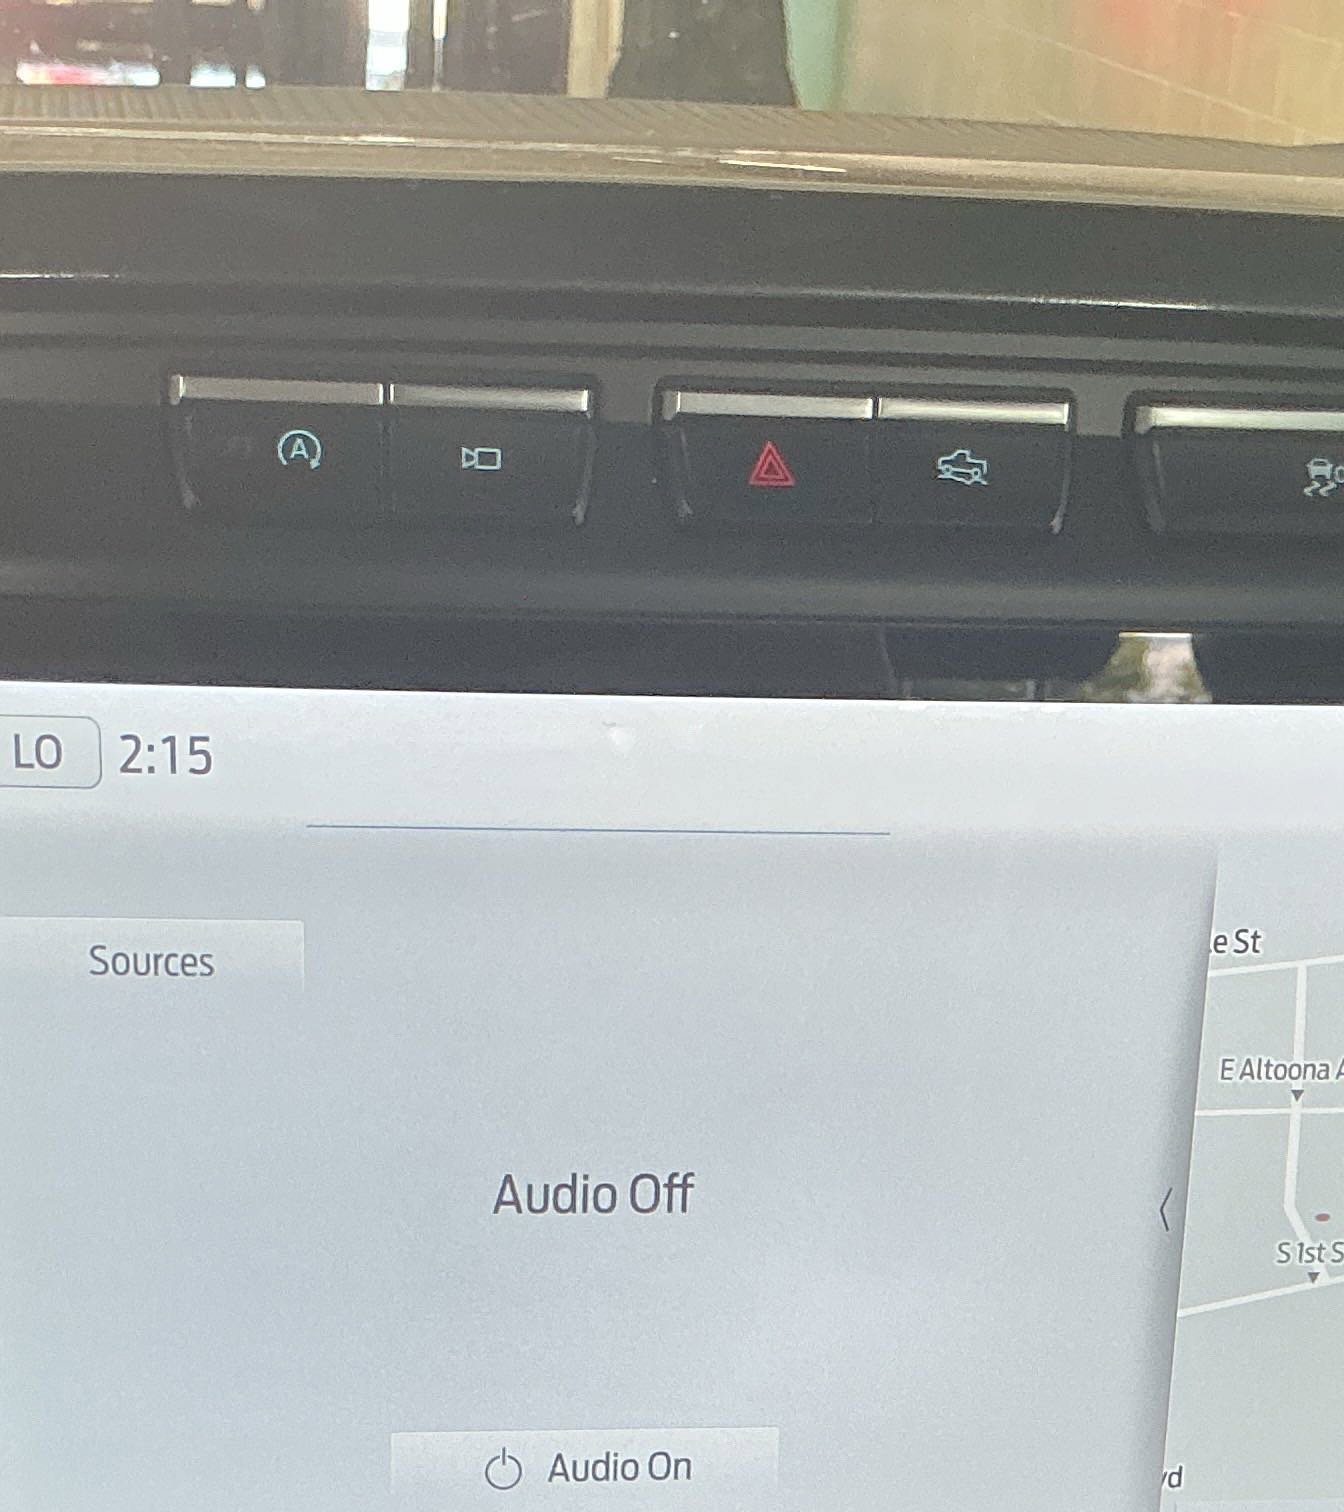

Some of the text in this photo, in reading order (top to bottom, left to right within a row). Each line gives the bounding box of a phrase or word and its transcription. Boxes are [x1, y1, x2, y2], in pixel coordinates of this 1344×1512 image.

[289, 438, 310, 461] A
[12, 733, 63, 769] LO
[119, 734, 213, 775] 2:15
[1233, 929, 1262, 954] St
[89, 944, 215, 977] Sources
[1220, 1059, 1234, 1081] E
[1239, 1058, 1330, 1081] Altoona
[492, 1171, 695, 1214] Audio Off
[1277, 1243, 1292, 1264] S
[1296, 1243, 1326, 1264] 1st
[548, 1450, 692, 1483] Audio On
